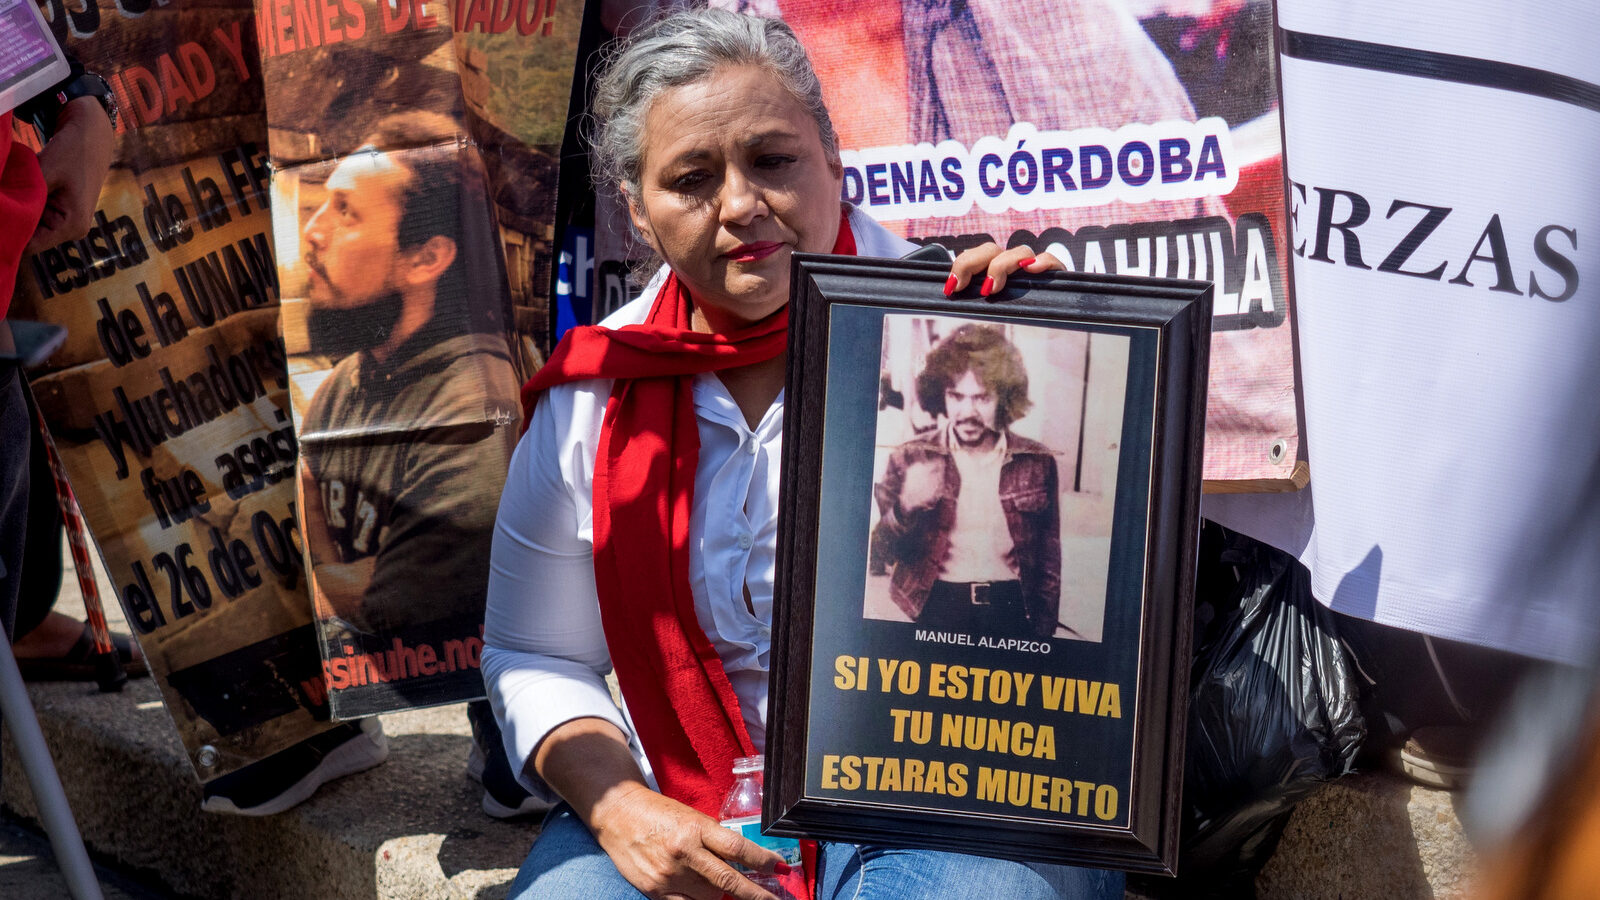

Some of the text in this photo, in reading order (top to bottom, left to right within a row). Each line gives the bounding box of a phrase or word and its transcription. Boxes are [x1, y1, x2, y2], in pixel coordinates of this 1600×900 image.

[213, 21, 250, 82] Y
[978, 134, 1227, 198] CÓRDOBA
[143, 183, 194, 253] de
[181, 166, 232, 232] la
[96, 232, 281, 368] de la UNAM
[93, 410, 129, 480] y
[112, 344, 268, 457] luchador
[140, 467, 211, 530] fue
[122, 560, 167, 634] el
[152, 542, 212, 620] 26
[208, 526, 262, 600] de
[915, 629, 1051, 655] MANUEL ALAPIZCO
[834, 654, 1122, 719] SI YO ESTOY VIVA
[890, 708, 1056, 760] TU NUNCA
[821, 755, 1119, 821] ESTARAS MUERTO
